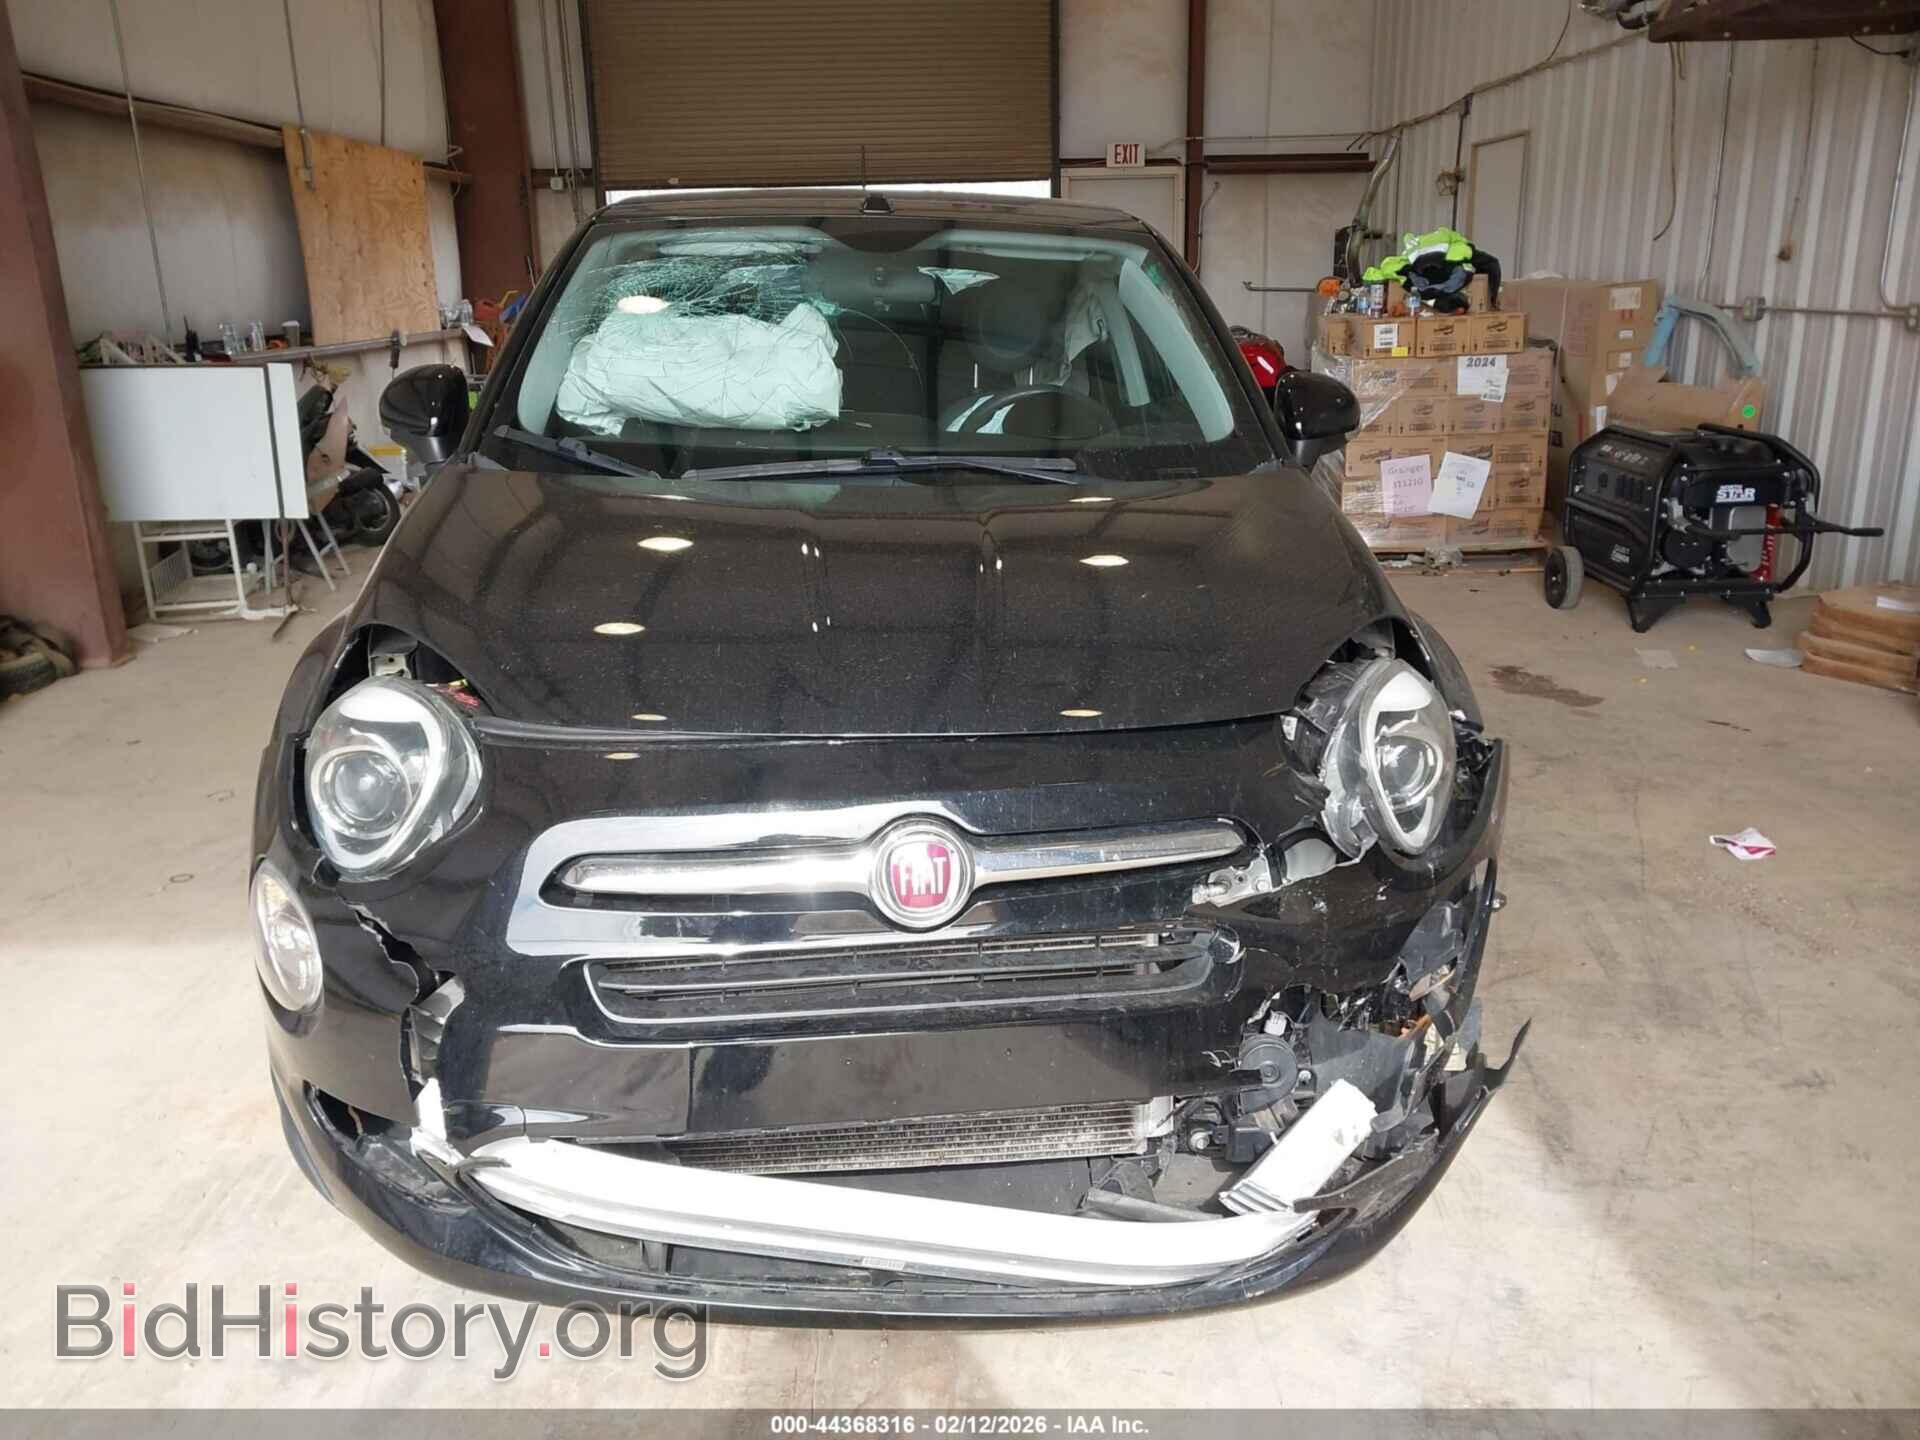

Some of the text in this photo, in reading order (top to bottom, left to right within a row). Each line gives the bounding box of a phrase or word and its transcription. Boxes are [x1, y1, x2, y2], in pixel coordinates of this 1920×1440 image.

[1114, 143, 1140, 165] EXIT
[1465, 356, 1497, 368] 2024
[1716, 488, 1756, 501] STAR
[898, 855, 948, 897] FIAT
